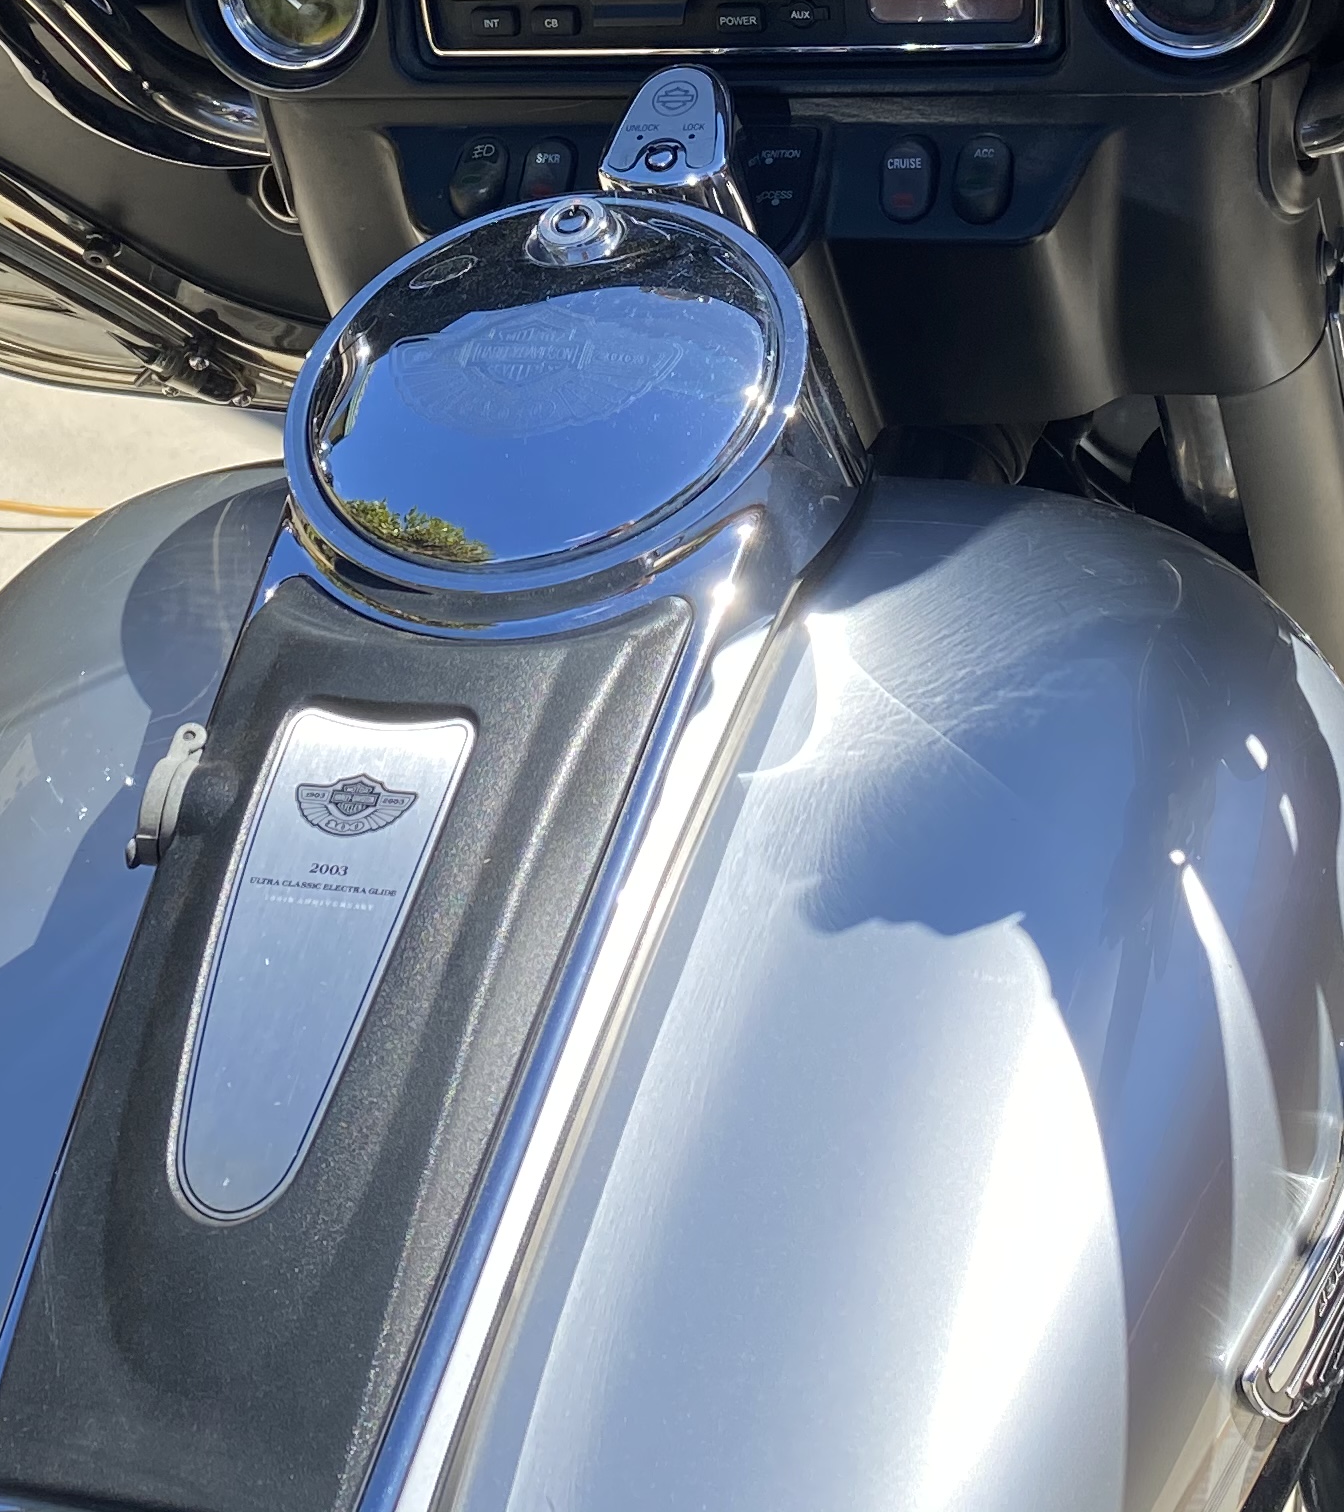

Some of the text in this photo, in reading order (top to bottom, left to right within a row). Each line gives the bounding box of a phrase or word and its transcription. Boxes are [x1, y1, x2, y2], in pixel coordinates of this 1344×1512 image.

[719, 15, 758, 27] POWER
[790, 9, 811, 21] AUX
[483, 18, 499, 29] INT
[544, 18, 559, 29] CB
[625, 123, 706, 132] UNLOCK LOCK
[536, 152, 561, 164] SPKR
[761, 149, 801, 159] IGNITION
[974, 148, 995, 158] ACC
[887, 157, 922, 169] CRUISE
[309, 862, 349, 877] 2003
[249, 876, 397, 897] ULTRA CLASSIC ELECTRA GLIDE
